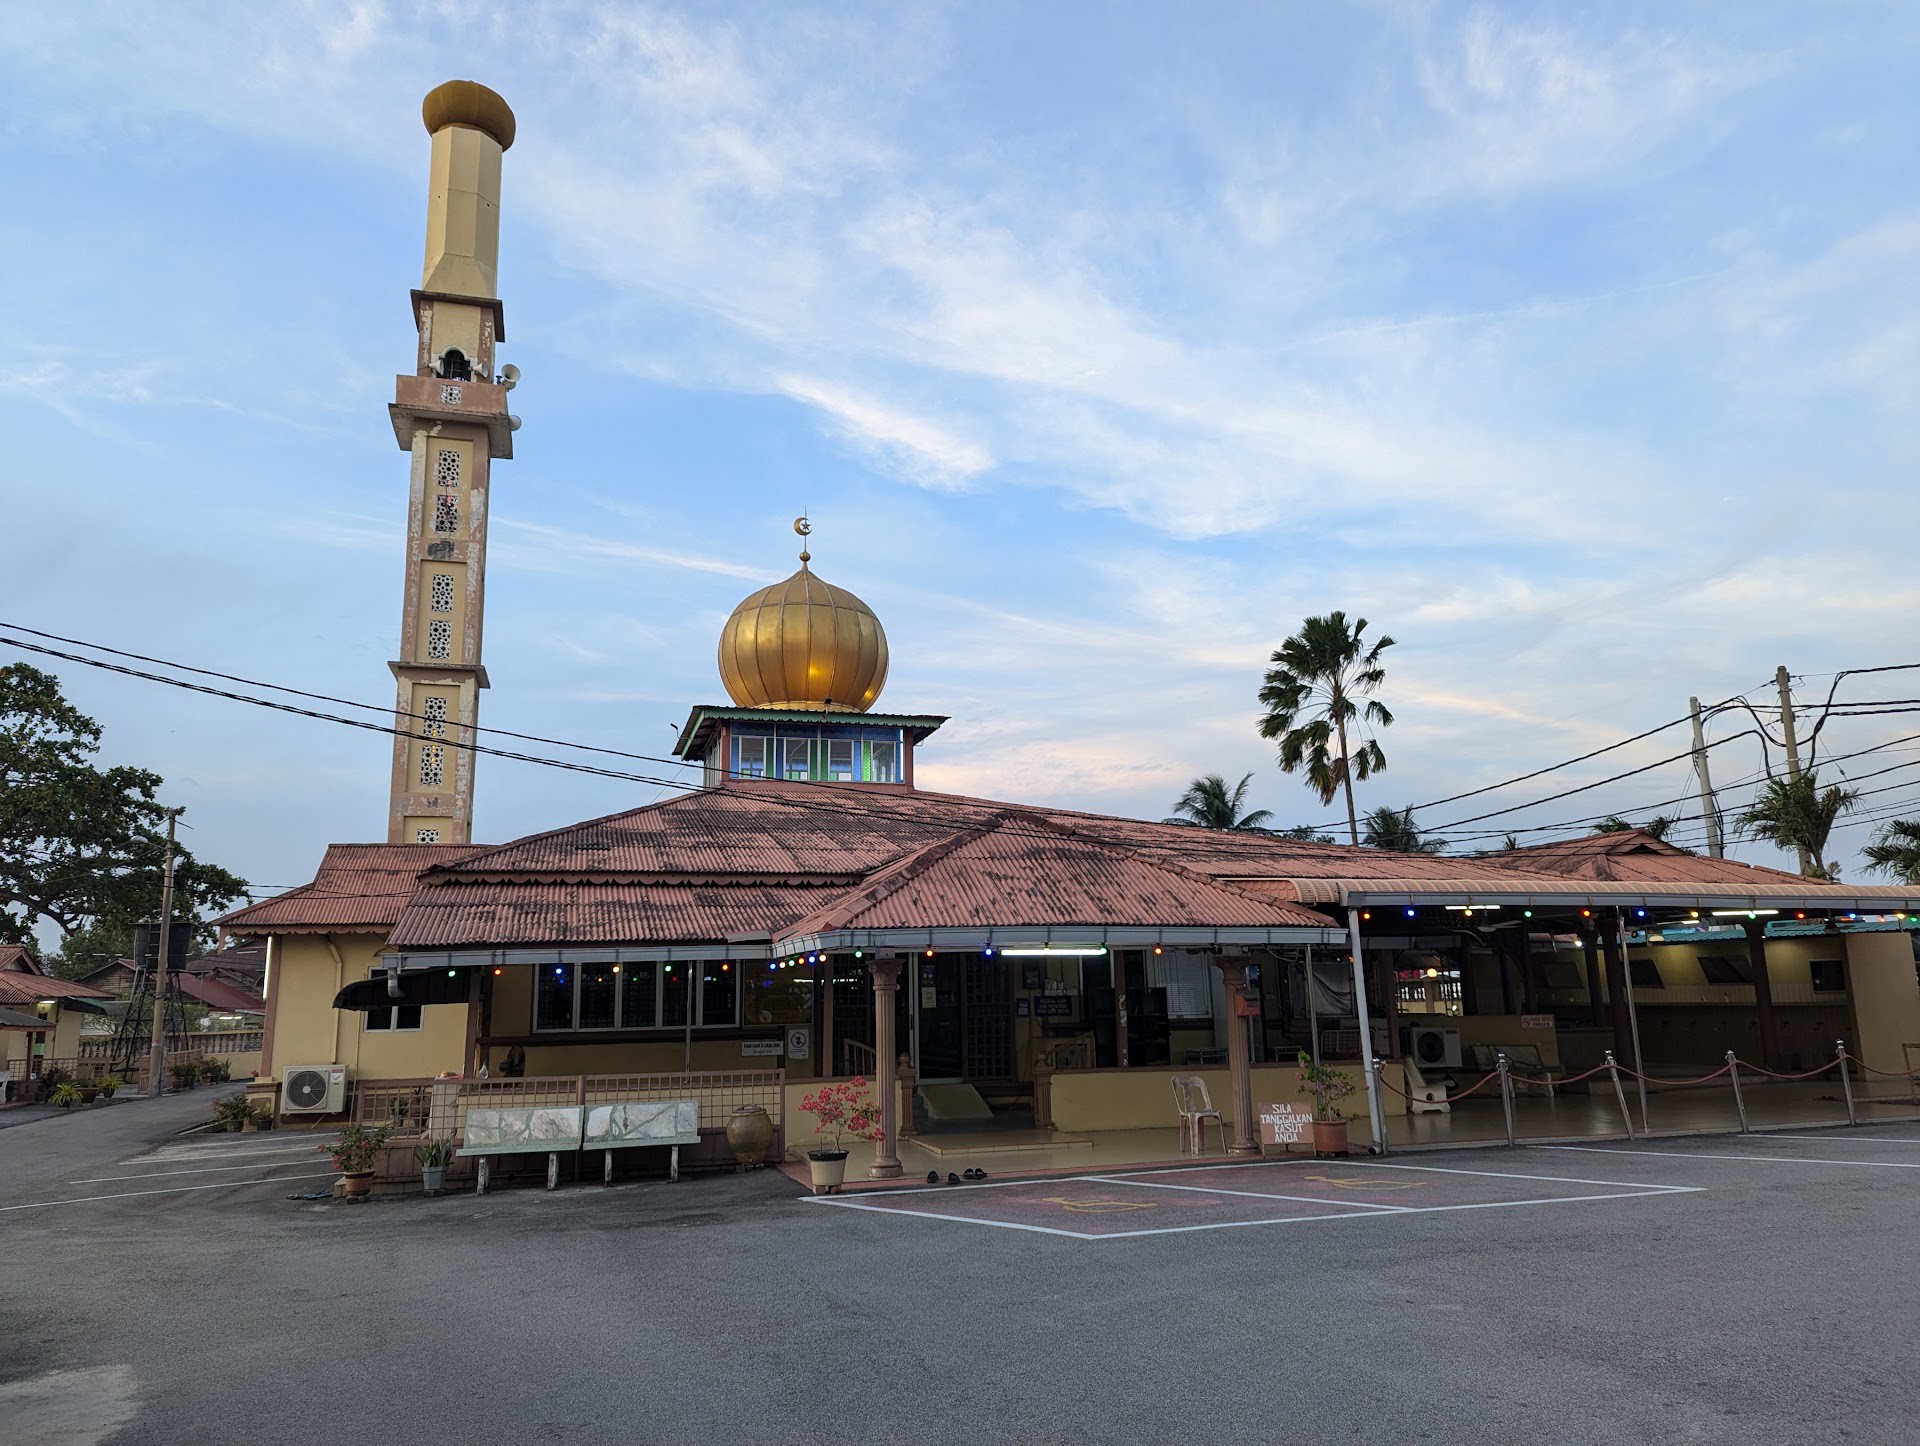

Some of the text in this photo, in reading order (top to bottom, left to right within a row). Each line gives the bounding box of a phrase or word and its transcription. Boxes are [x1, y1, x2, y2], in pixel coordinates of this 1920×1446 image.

[1271, 1103, 1292, 1114] SILA
[1260, 1113, 1313, 1124] TANGGALKAN
[1274, 1123, 1304, 1133] KASUT
[1275, 1133, 1299, 1143] ANDA
